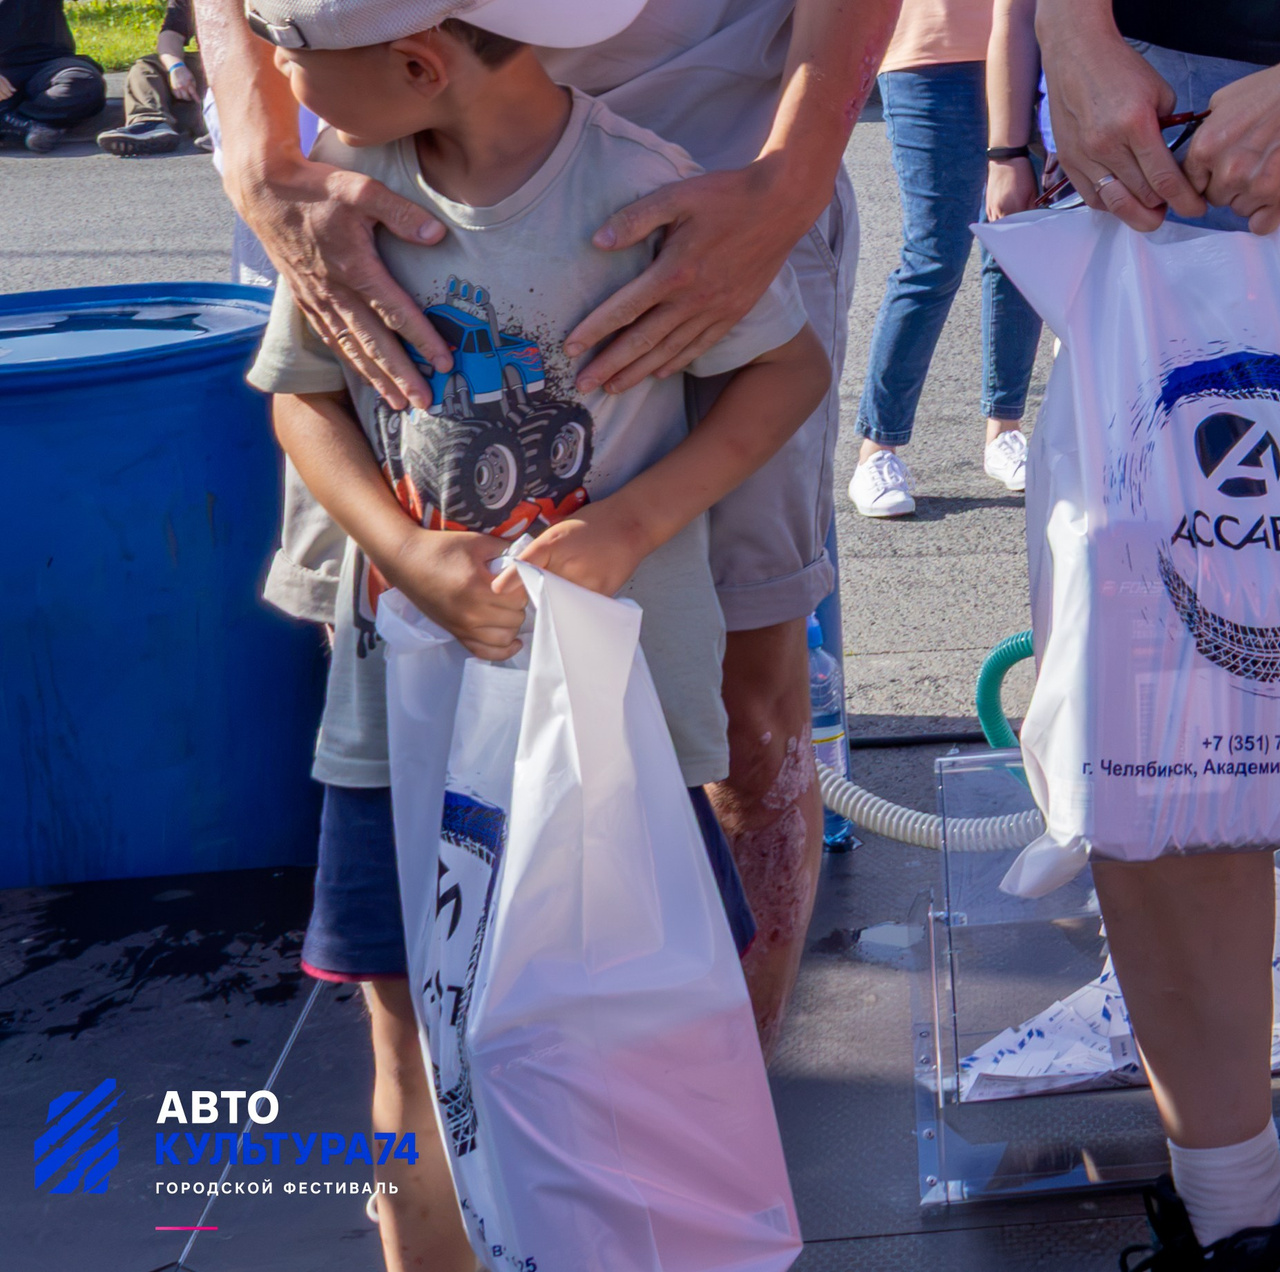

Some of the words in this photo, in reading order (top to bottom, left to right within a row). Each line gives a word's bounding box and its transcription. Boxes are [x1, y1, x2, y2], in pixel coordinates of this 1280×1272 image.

[1202, 735, 1223, 751] +7
[1228, 734, 1270, 756] (351)
[1082, 762, 1094, 775] г.
